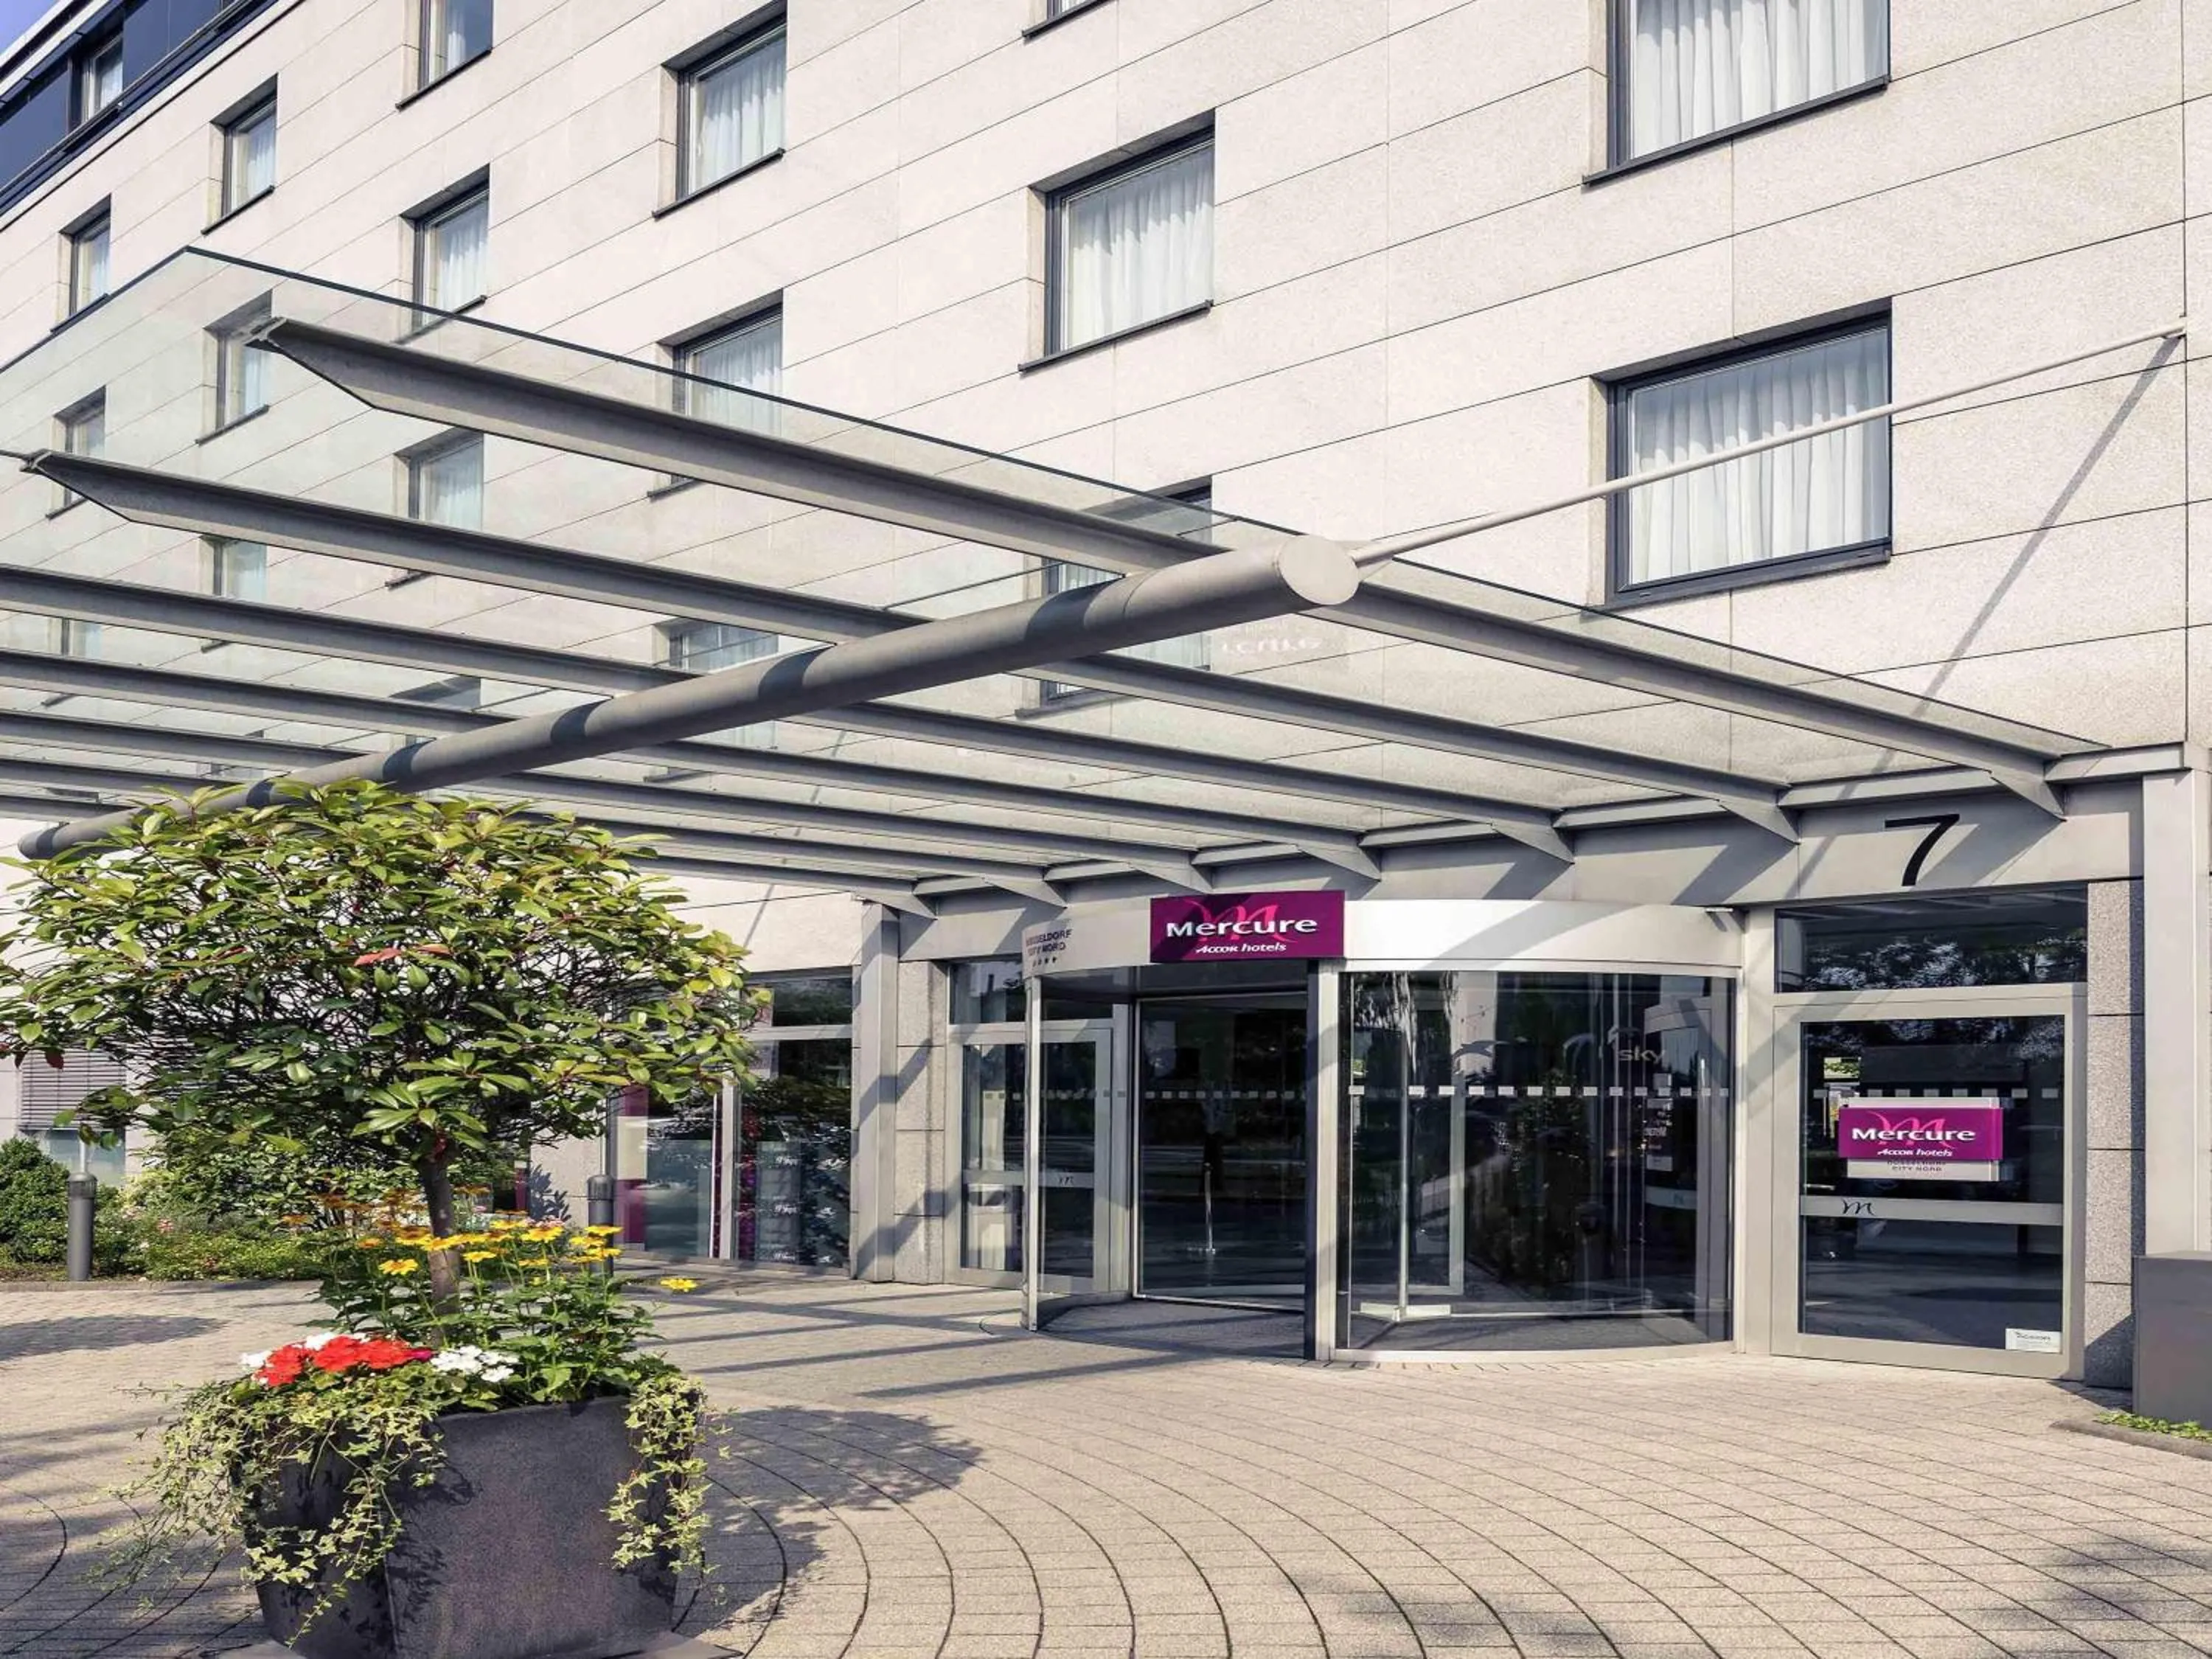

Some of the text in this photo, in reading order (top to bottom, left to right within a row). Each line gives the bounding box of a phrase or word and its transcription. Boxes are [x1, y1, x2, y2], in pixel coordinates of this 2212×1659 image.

[1885, 813, 1960, 886] 7
[1166, 919, 1318, 937] Mercure
[1241, 942, 1287, 953] hotels
[1618, 1046, 1666, 1064] sky
[1851, 1127, 1976, 1141] Mercure
[1916, 1148, 1953, 1157] hotels
